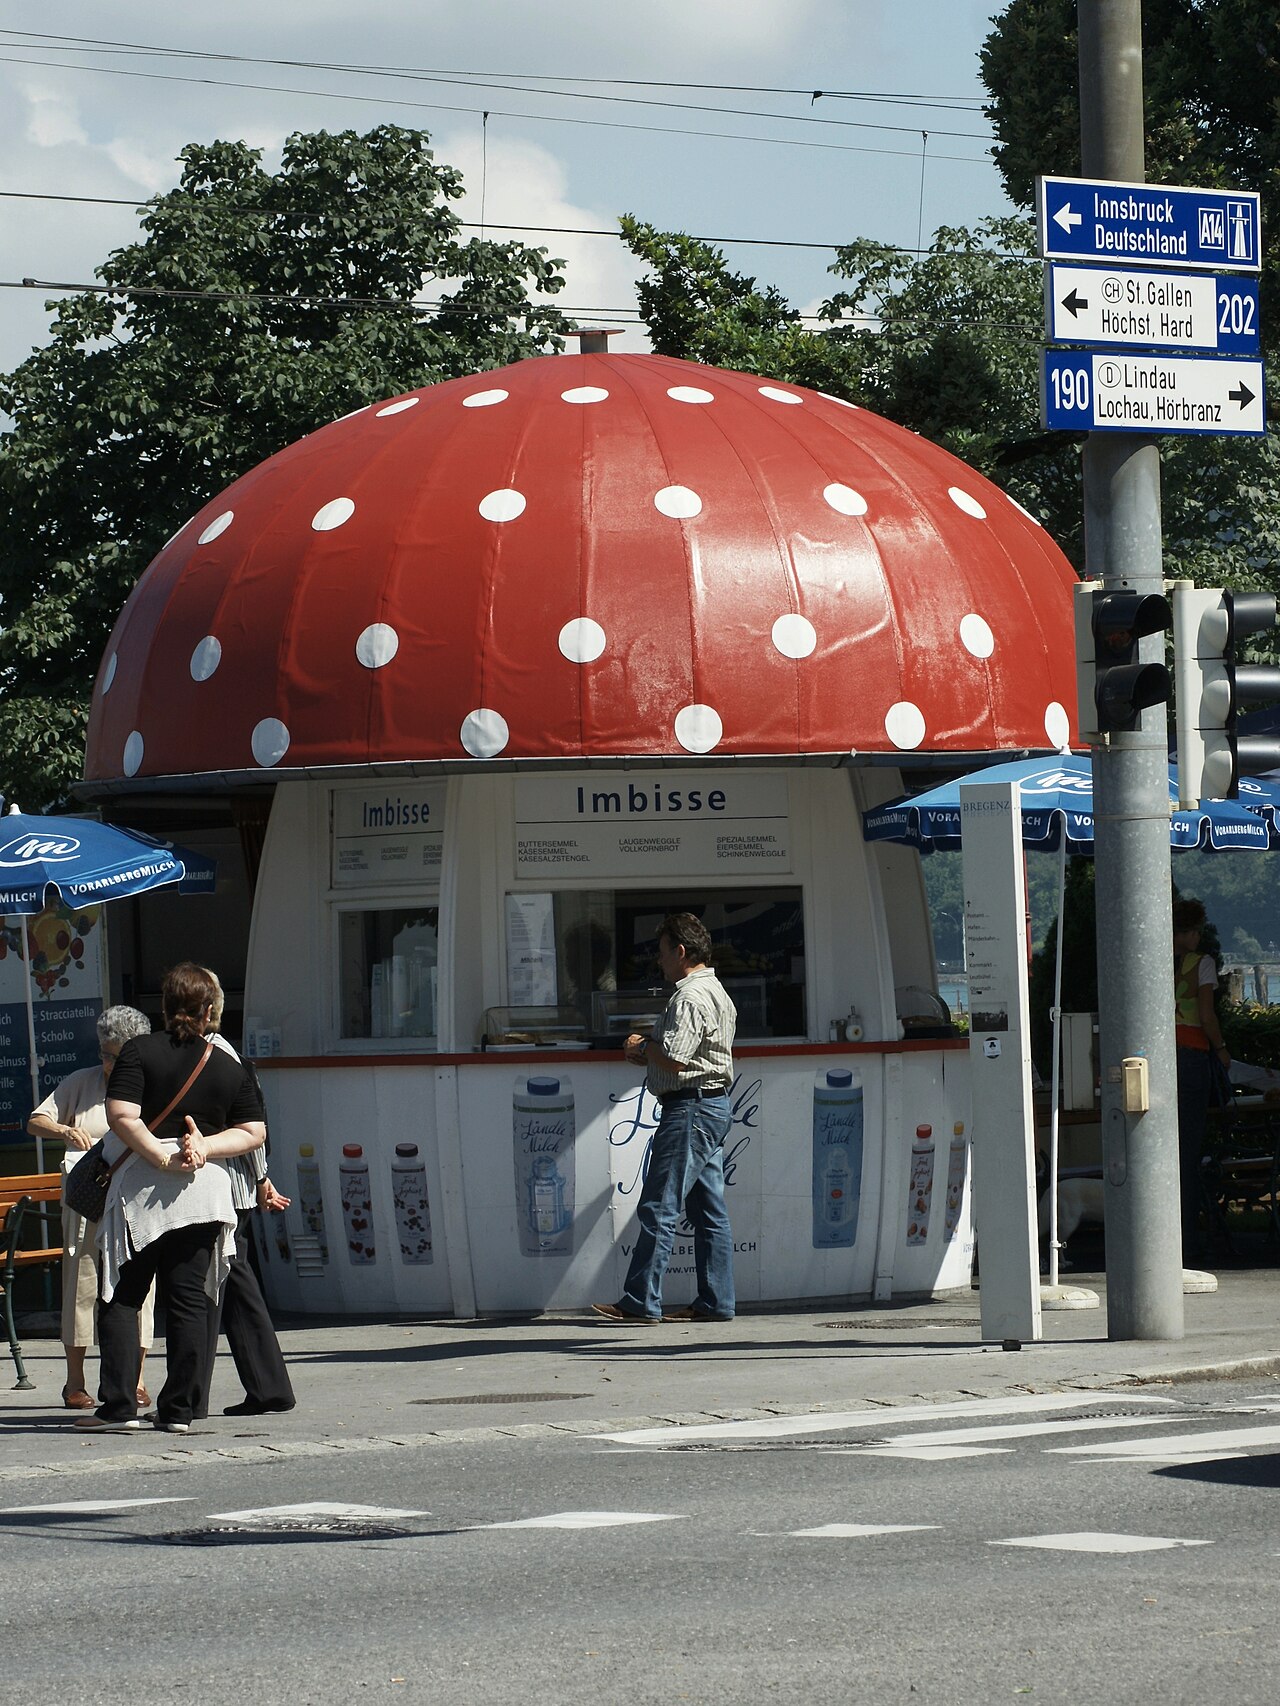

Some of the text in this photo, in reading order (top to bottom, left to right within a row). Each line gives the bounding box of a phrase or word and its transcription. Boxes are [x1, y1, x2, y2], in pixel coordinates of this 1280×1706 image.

[1094, 192, 1174, 224] Innsbruck
[1200, 212, 1224, 245] A14
[1095, 223, 1187, 255] Deutschland
[1104, 282, 1121, 299] CH
[1218, 293, 1256, 335] 202
[1101, 308, 1193, 339] Höchst, Hard
[1124, 363, 1176, 390] Lindau
[1051, 368, 1089, 411] 190
[1156, 396, 1222, 422] Hörbranz
[577, 784, 727, 814] Imbisse
[963, 800, 1011, 812] BREGENZ
[362, 797, 431, 828] Imbisse
[518, 840, 579, 848] BUTTERSEMMEL
[618, 837, 682, 845] LAUGENWEGGLE
[716, 835, 778, 844] SPEZIALSEMMEL
[716, 843, 765, 851] EIERSEMMEL
[618, 845, 680, 853] VOLLKORNBROT
[716, 850, 787, 858] SCHINKENWEGGLE
[518, 855, 591, 863] KÄSESALZSTENGEL
[40, 1006, 95, 1022] Stracciatella
[41, 1030, 75, 1043] Schoko
[43, 1052, 77, 1064] Ananas
